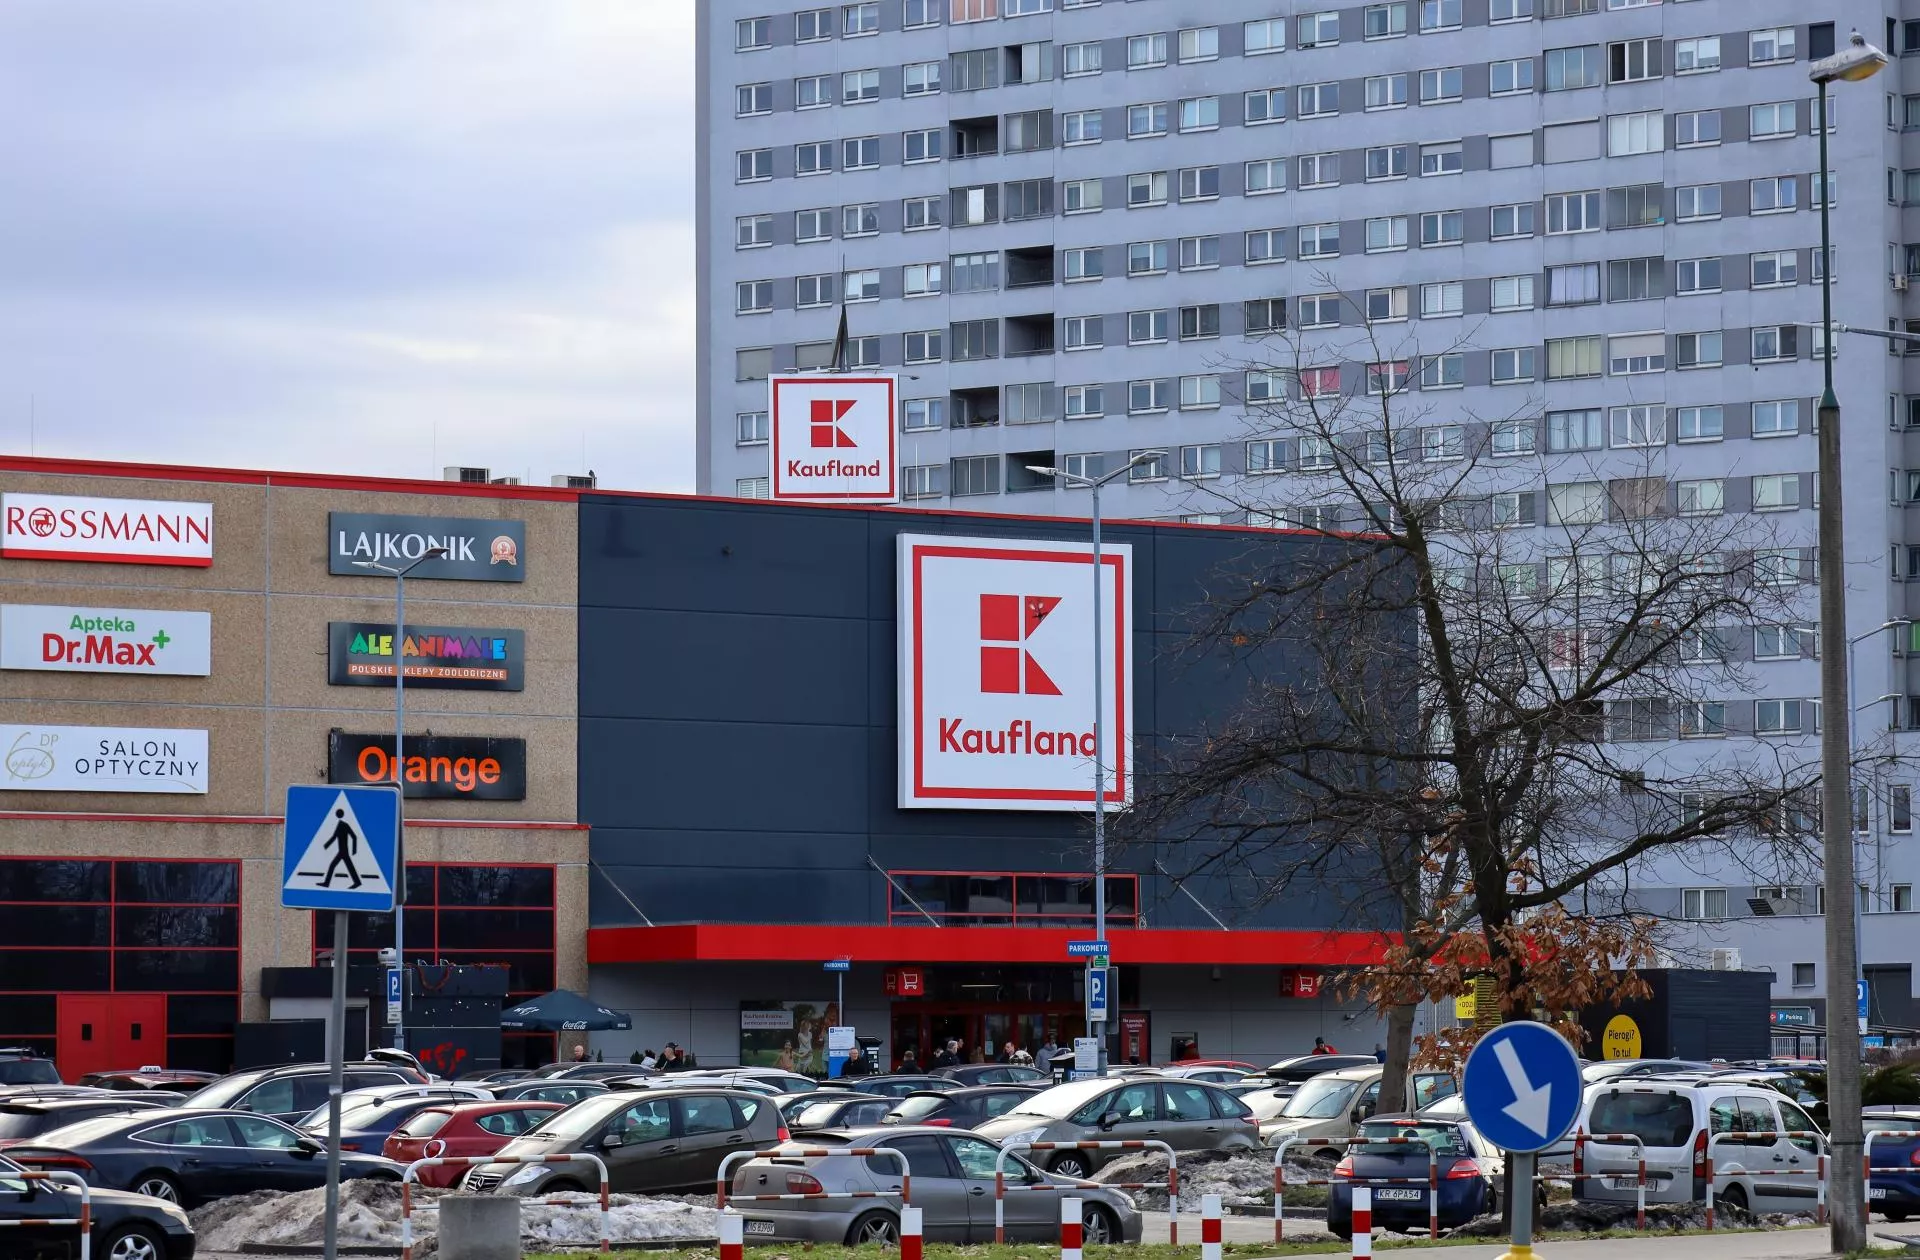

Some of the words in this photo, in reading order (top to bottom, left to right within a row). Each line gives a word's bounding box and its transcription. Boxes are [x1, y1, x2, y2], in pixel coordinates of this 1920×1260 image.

[788, 460, 880, 477] Kaufland
[7, 506, 209, 544] ROSSMANN
[339, 531, 476, 562] LAJKONIK
[69, 614, 135, 633] Apteka
[350, 632, 393, 656] ALE
[402, 635, 507, 660] ANIMALE
[351, 665, 393, 674] POLSKIE
[402, 667, 434, 676] KLEPY
[438, 668, 504, 678] ZOOLOGICZNE
[40, 734, 59, 746] DP
[939, 717, 1097, 756] Kaufland
[99, 740, 176, 757] SALON
[75, 758, 199, 776] OPTYCZNY
[357, 746, 501, 791] Orange
[1069, 944, 1108, 952] PARKOMETR
[392, 976, 398, 996] P
[1092, 977, 1101, 1002] P
[1608, 1029, 1635, 1042] Pierogi?
[1612, 1047, 1620, 1058] To
[1379, 1189, 1391, 1199] KR
[1392, 1189, 1420, 1199] 6PA54
